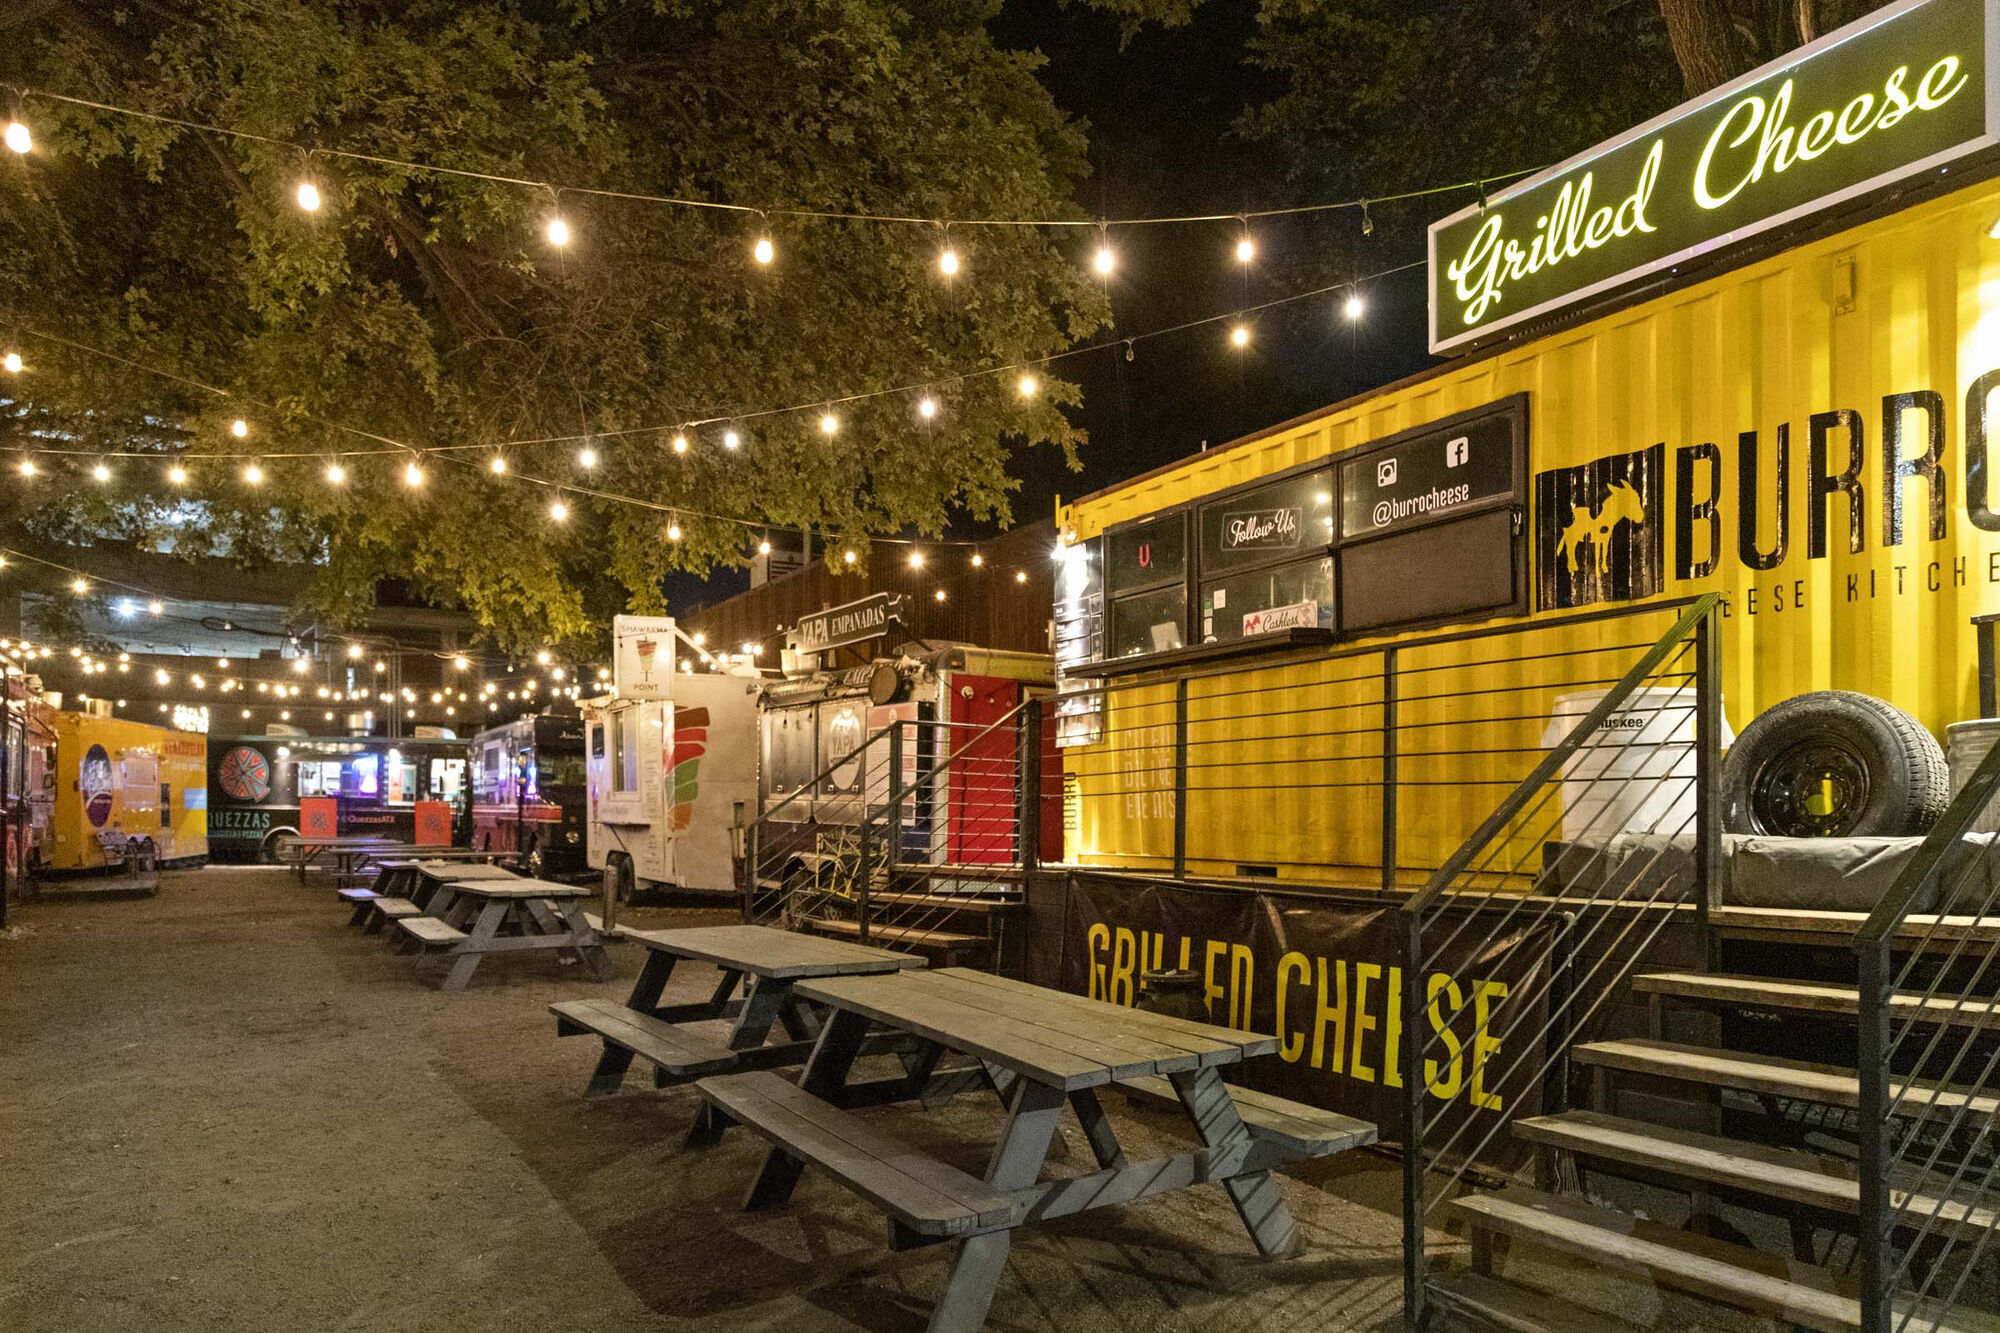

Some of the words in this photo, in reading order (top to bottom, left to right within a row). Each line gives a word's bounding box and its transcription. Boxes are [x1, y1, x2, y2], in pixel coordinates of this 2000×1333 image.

[1448, 138, 1663, 325] Grilled
[1694, 56, 1969, 210] Cheese
[1373, 484, 1469, 528] @burrocheese
[1231, 515, 1274, 547] Follow
[1275, 508, 1295, 534] Us
[802, 617, 829, 645] YAPA
[832, 604, 885, 636] EMPANADAS
[1262, 609, 1300, 632] Cashless
[634, 684, 659, 692] POINT
[1599, 717, 1645, 729] uskee
[1276, 951, 1508, 1112] CHEESE
